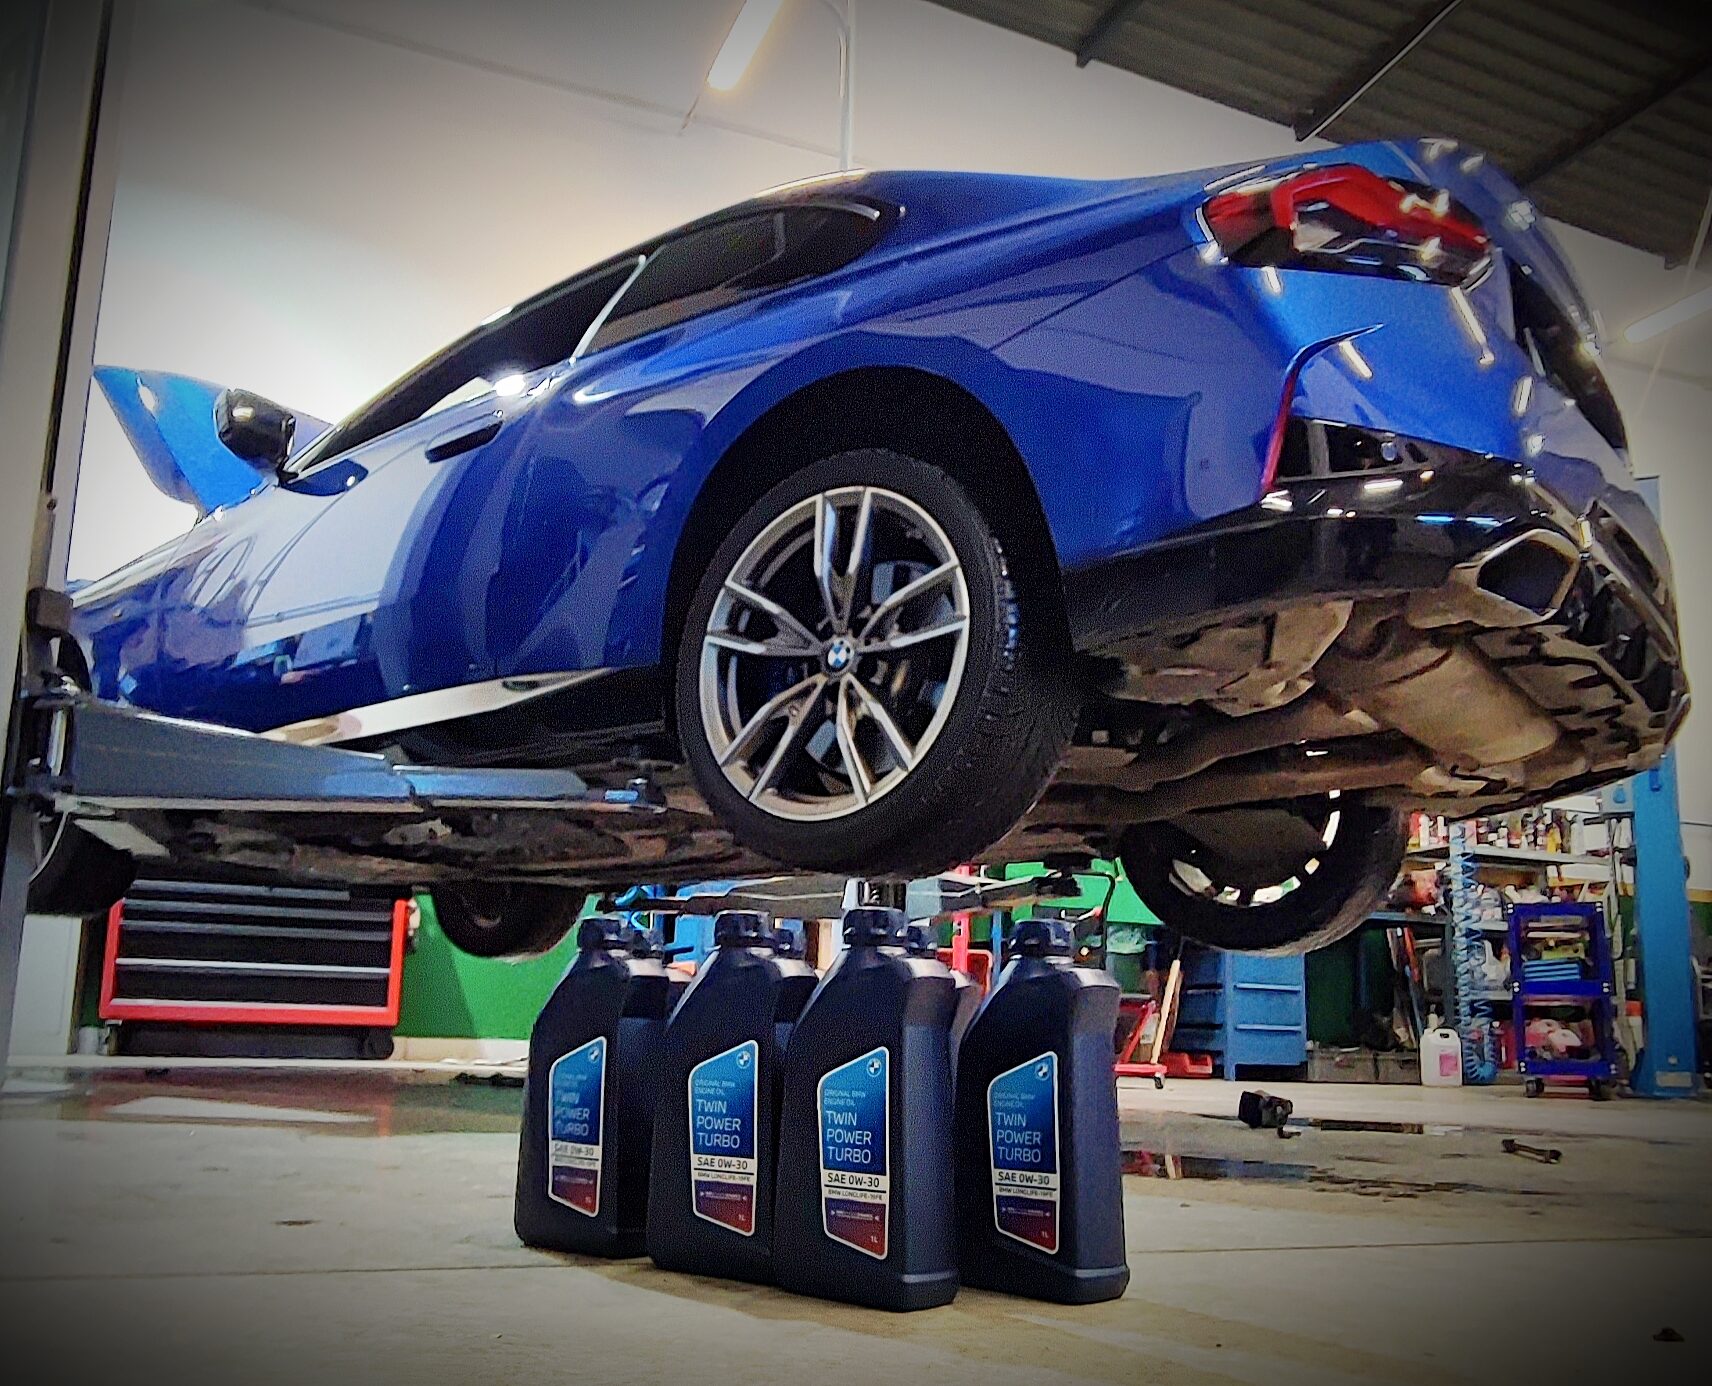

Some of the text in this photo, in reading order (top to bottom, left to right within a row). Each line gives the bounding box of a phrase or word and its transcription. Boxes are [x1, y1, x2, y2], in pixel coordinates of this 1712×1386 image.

[696, 1099, 727, 1114] TWIN
[696, 1115, 742, 1131] POWER
[825, 1110, 857, 1127] TWIN
[995, 1111, 1027, 1127] TWIN
[697, 1132, 740, 1149] TURBO
[826, 1128, 872, 1145] POWER
[996, 1129, 1042, 1145] POWER
[827, 1146, 871, 1164] TURBO
[997, 1146, 1042, 1163] TURBO
[697, 1157, 748, 1170] SAE 0W-30
[827, 1172, 880, 1188] SAE 0W-30
[998, 1171, 1050, 1186] SAE 0W-30
